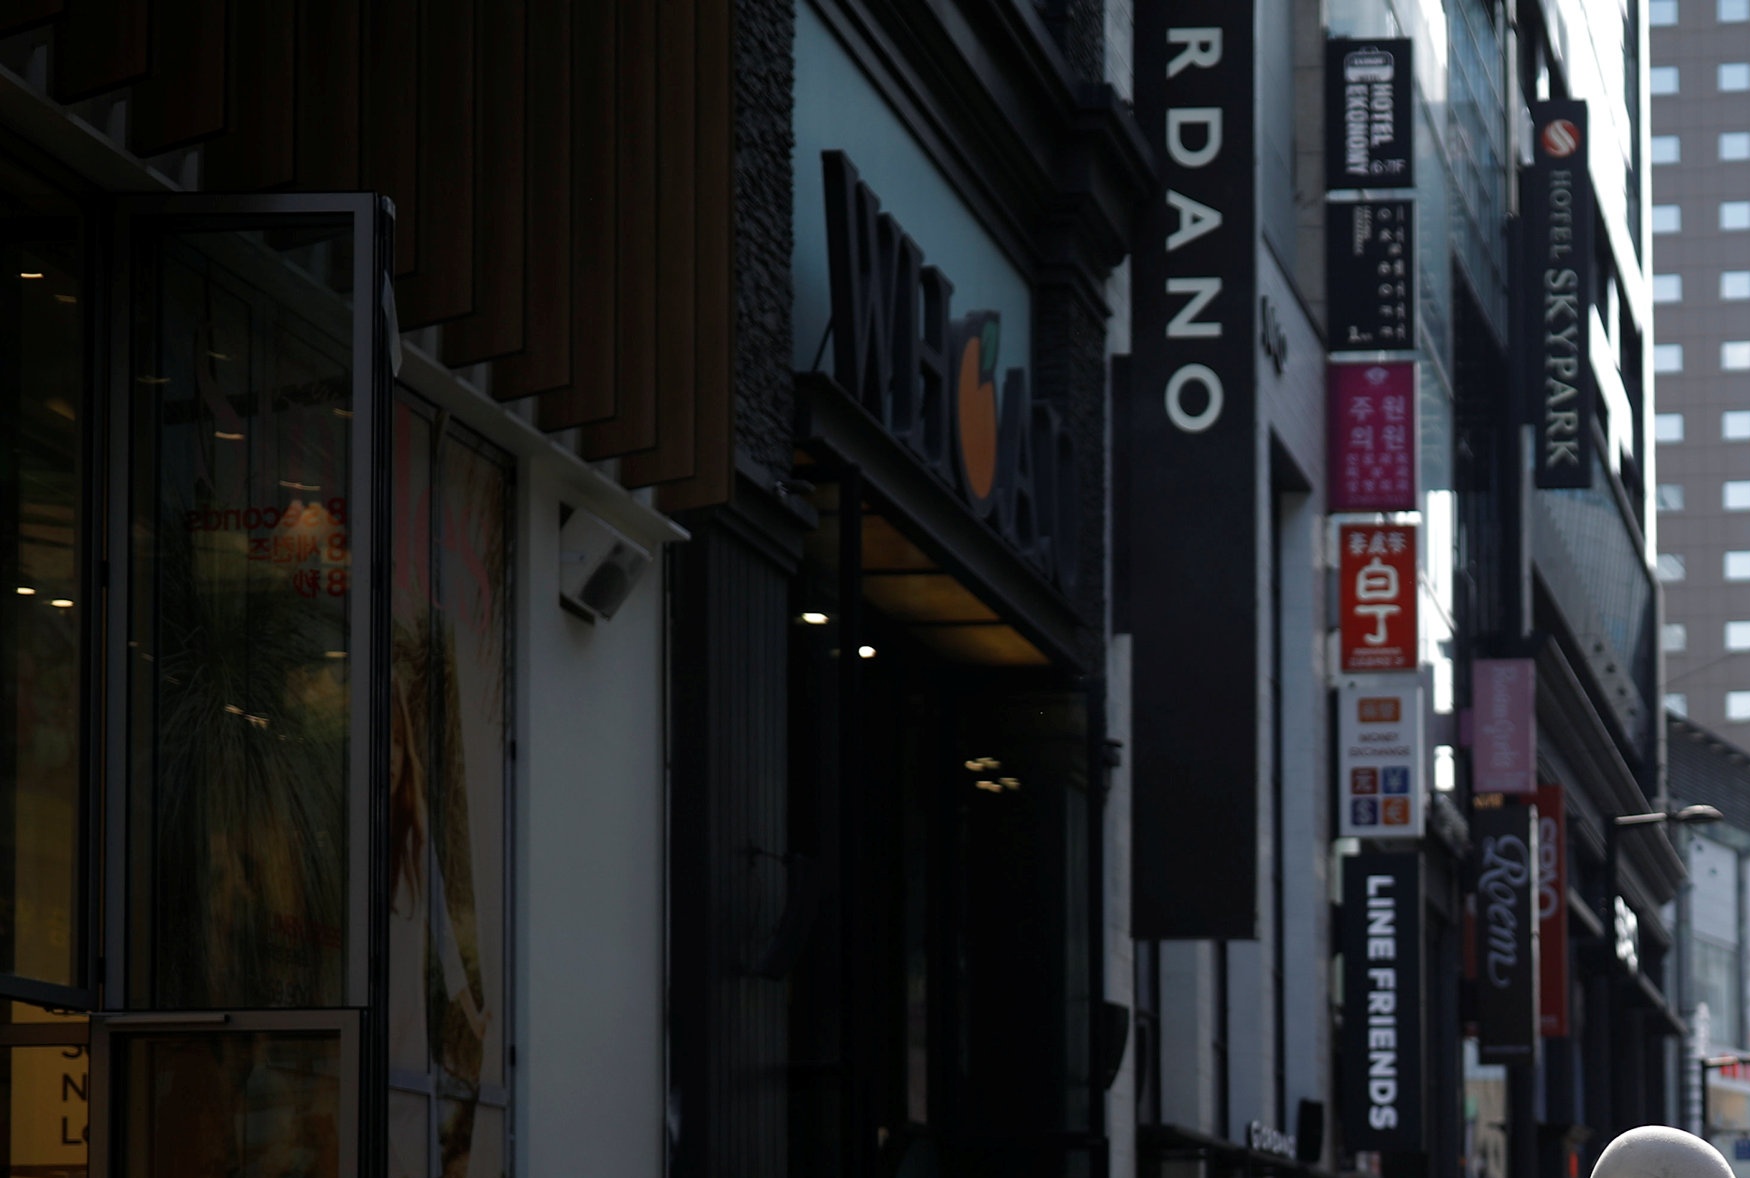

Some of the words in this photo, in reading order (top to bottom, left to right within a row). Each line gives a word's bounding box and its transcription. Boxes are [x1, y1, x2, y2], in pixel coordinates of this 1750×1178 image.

[1345, 83, 1369, 175] EKONOMY
[1369, 82, 1394, 147] HOTEL
[1550, 170, 1572, 260] HOTEL
[1544, 268, 1579, 469] SKYPARK
[1353, 556, 1402, 646] 白丁
[1366, 874, 1396, 960] LINE
[1367, 968, 1399, 1131] FRIENDS
